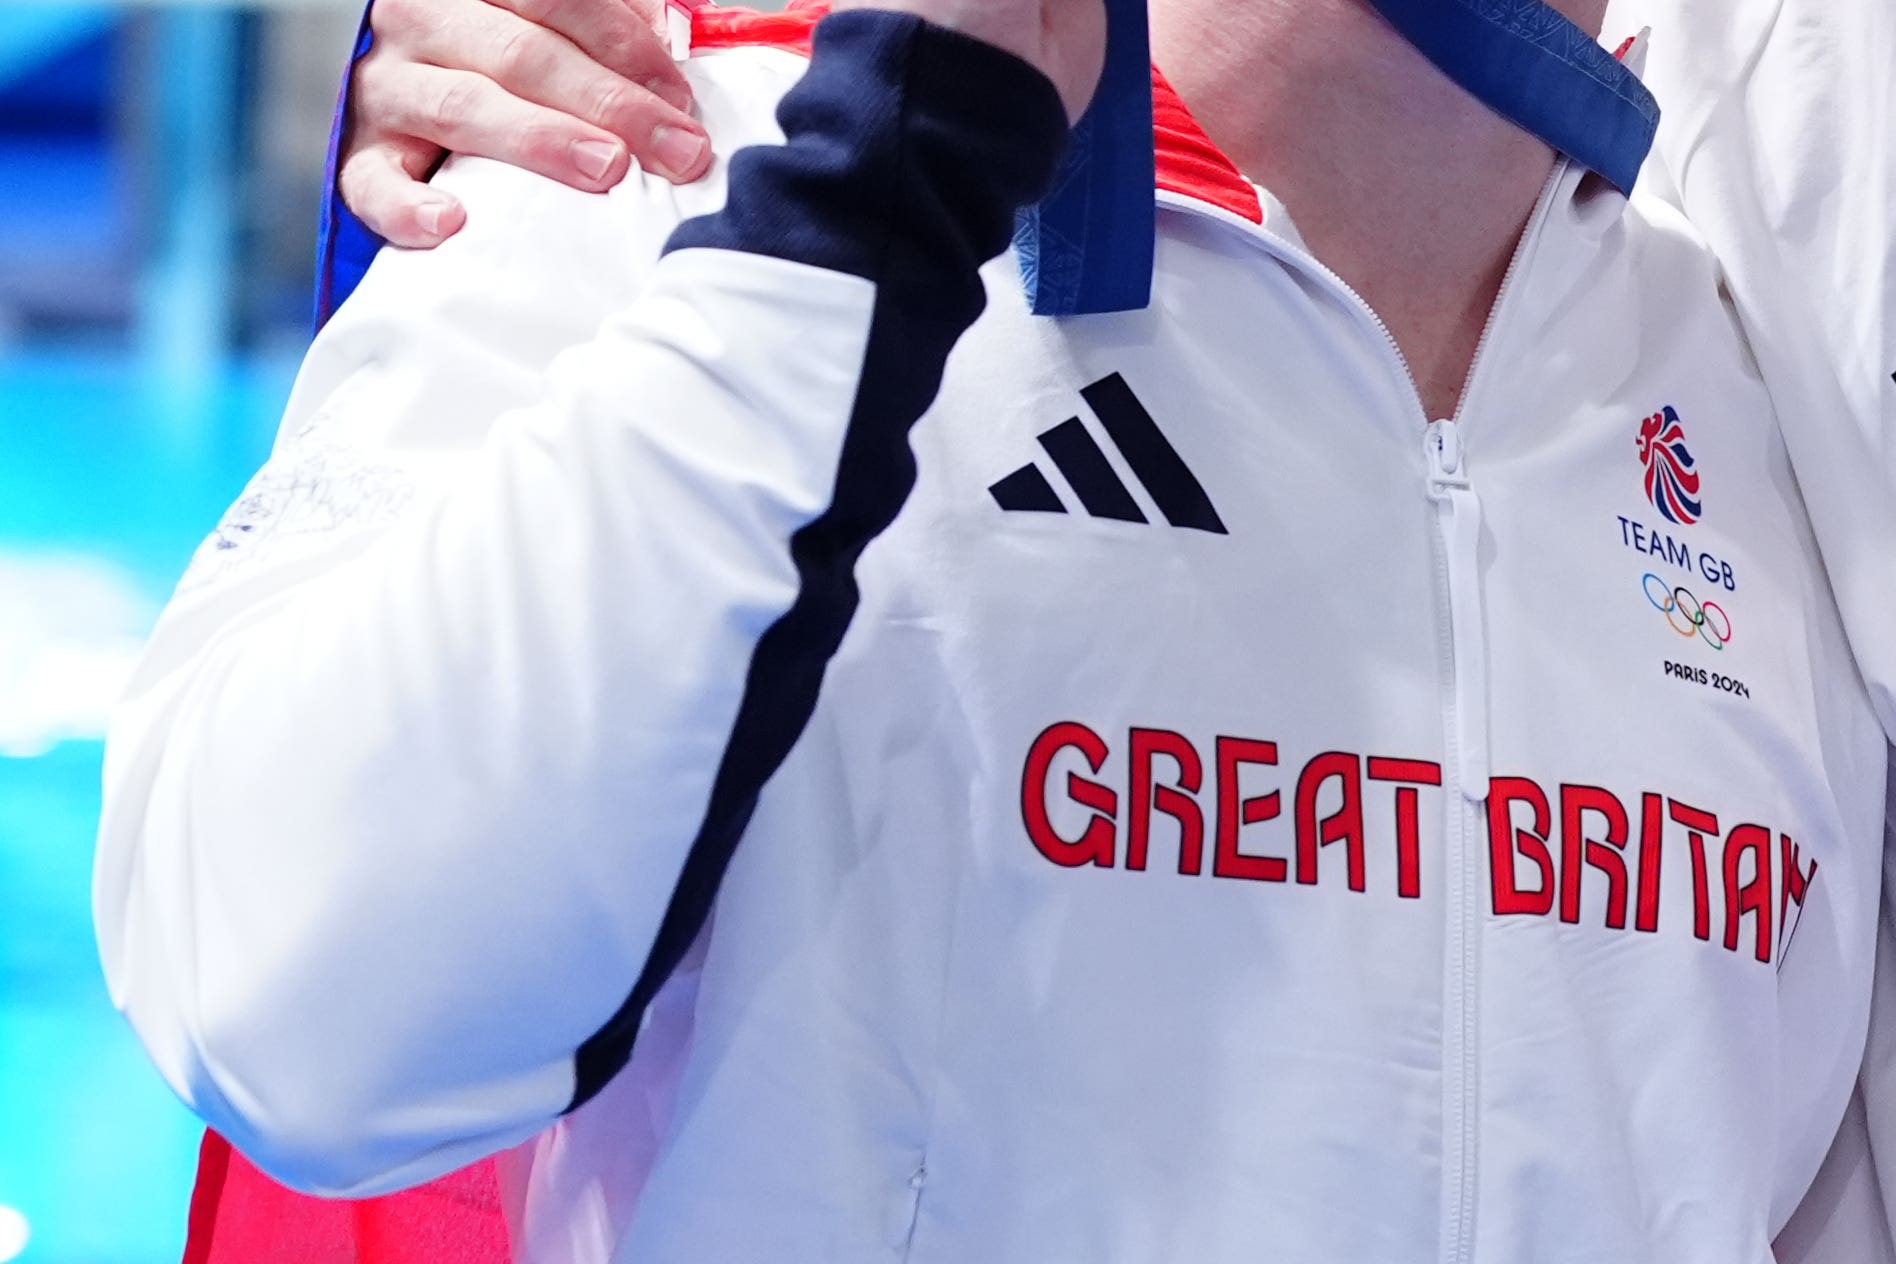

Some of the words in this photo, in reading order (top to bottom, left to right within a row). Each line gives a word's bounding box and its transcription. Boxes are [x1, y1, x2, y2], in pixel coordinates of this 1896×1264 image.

[1616, 515, 1692, 573] TEAM
[1699, 552, 1736, 591] GB
[1711, 672, 1751, 700] 2024
[1020, 721, 1442, 899] GREAT
